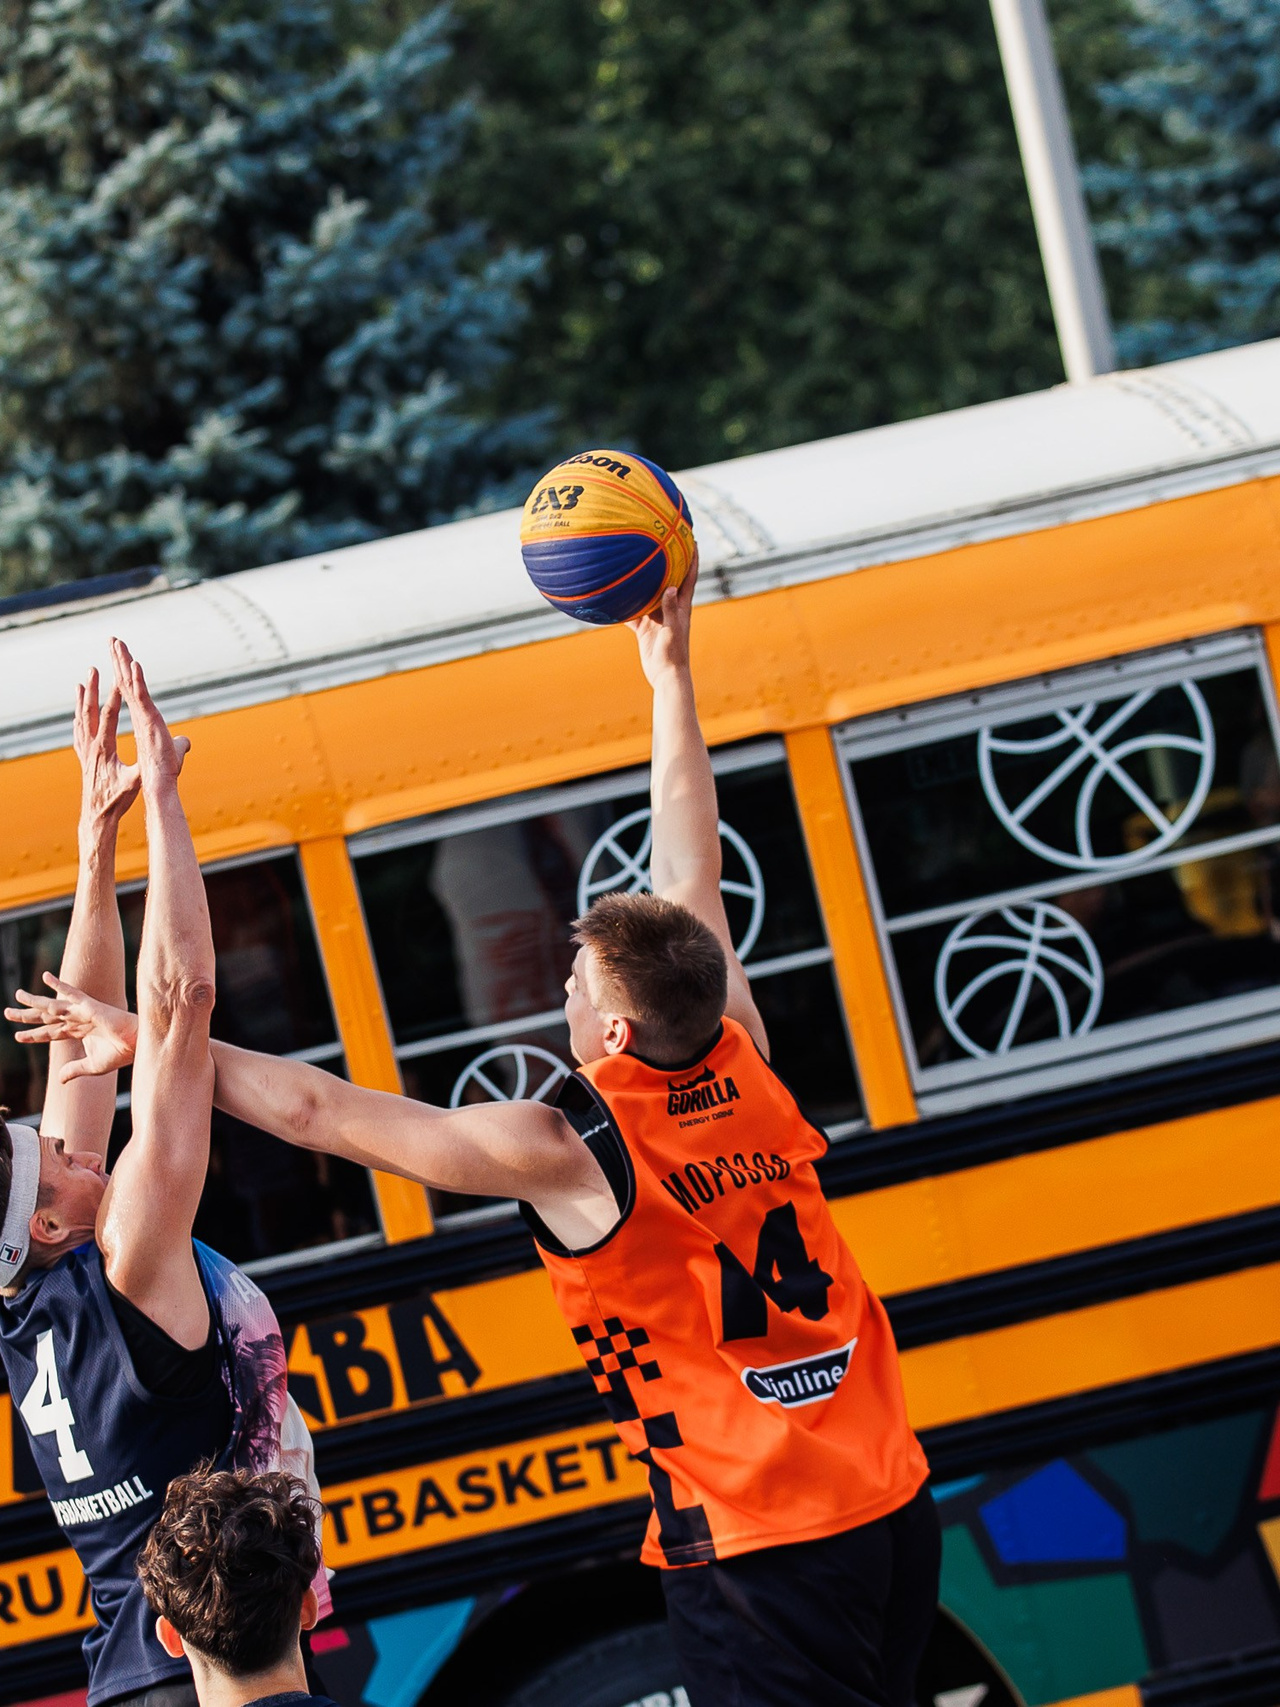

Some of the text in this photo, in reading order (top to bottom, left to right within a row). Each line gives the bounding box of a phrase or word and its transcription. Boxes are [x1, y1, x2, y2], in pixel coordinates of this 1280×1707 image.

[667, 1076, 741, 1116] GORILLA
[679, 1114, 710, 1128] ENERGY
[20, 1328, 94, 1484] 4
